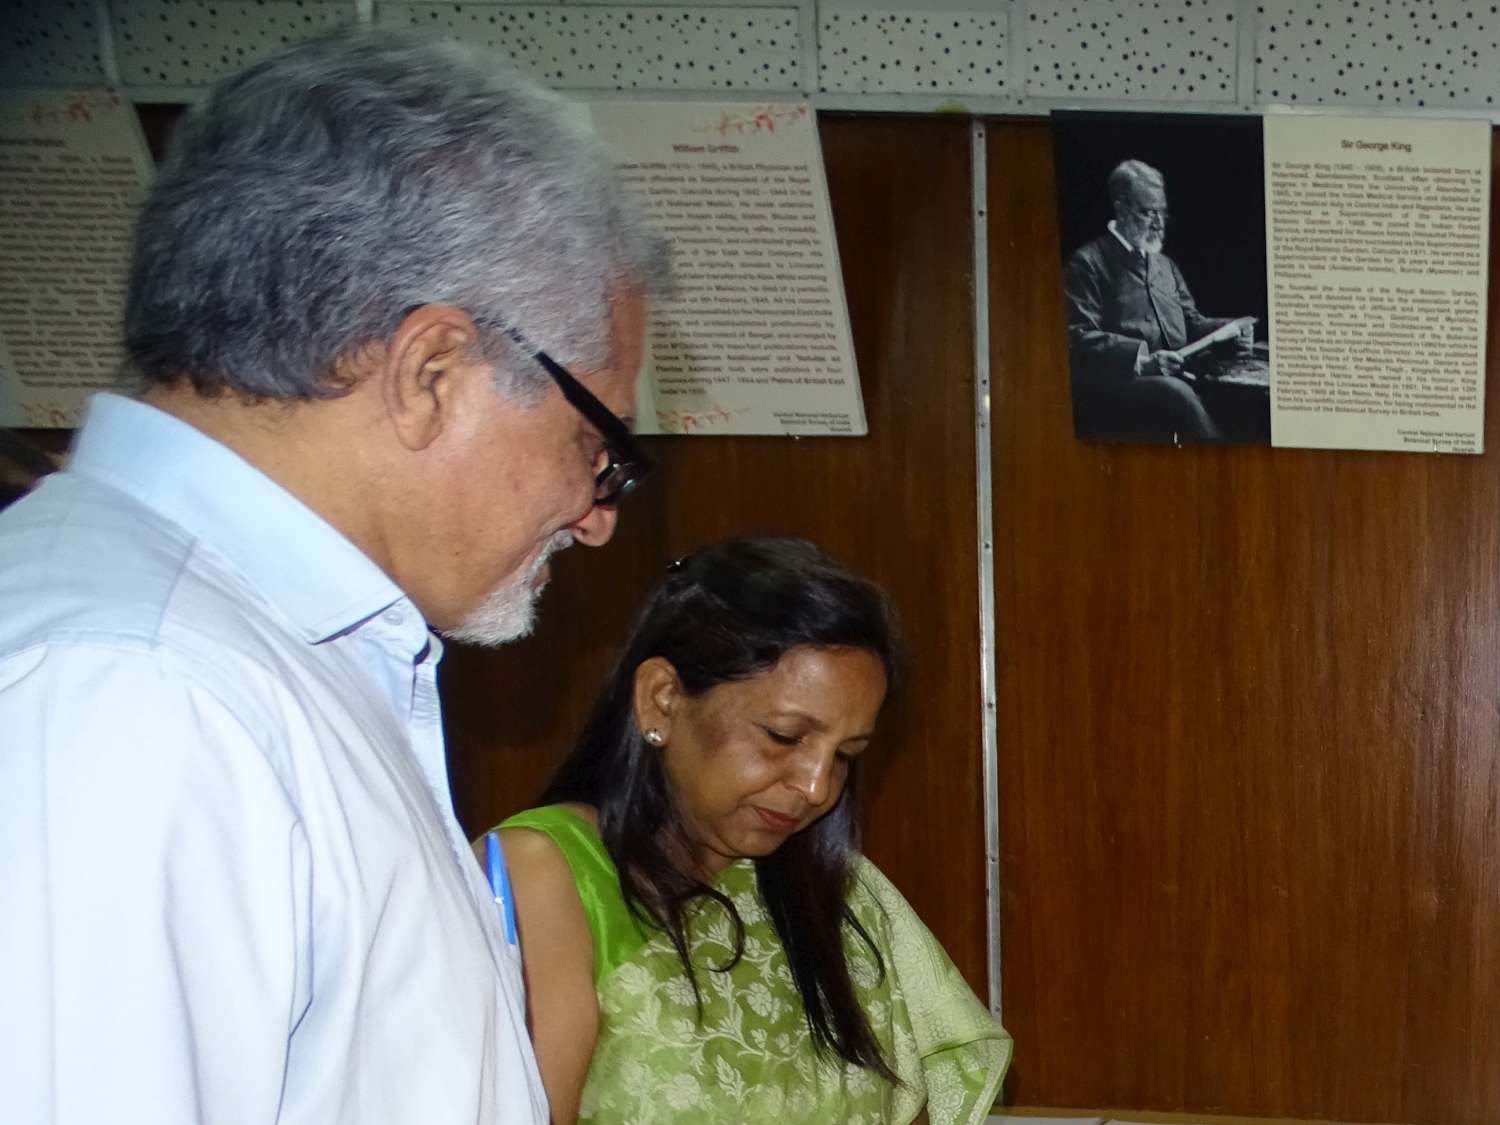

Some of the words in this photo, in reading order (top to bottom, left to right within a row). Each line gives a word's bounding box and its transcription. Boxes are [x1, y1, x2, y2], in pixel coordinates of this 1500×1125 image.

[1341, 139, 1353, 149] Sir
[1356, 140, 1388, 152] George
[1391, 141, 1412, 152] King
